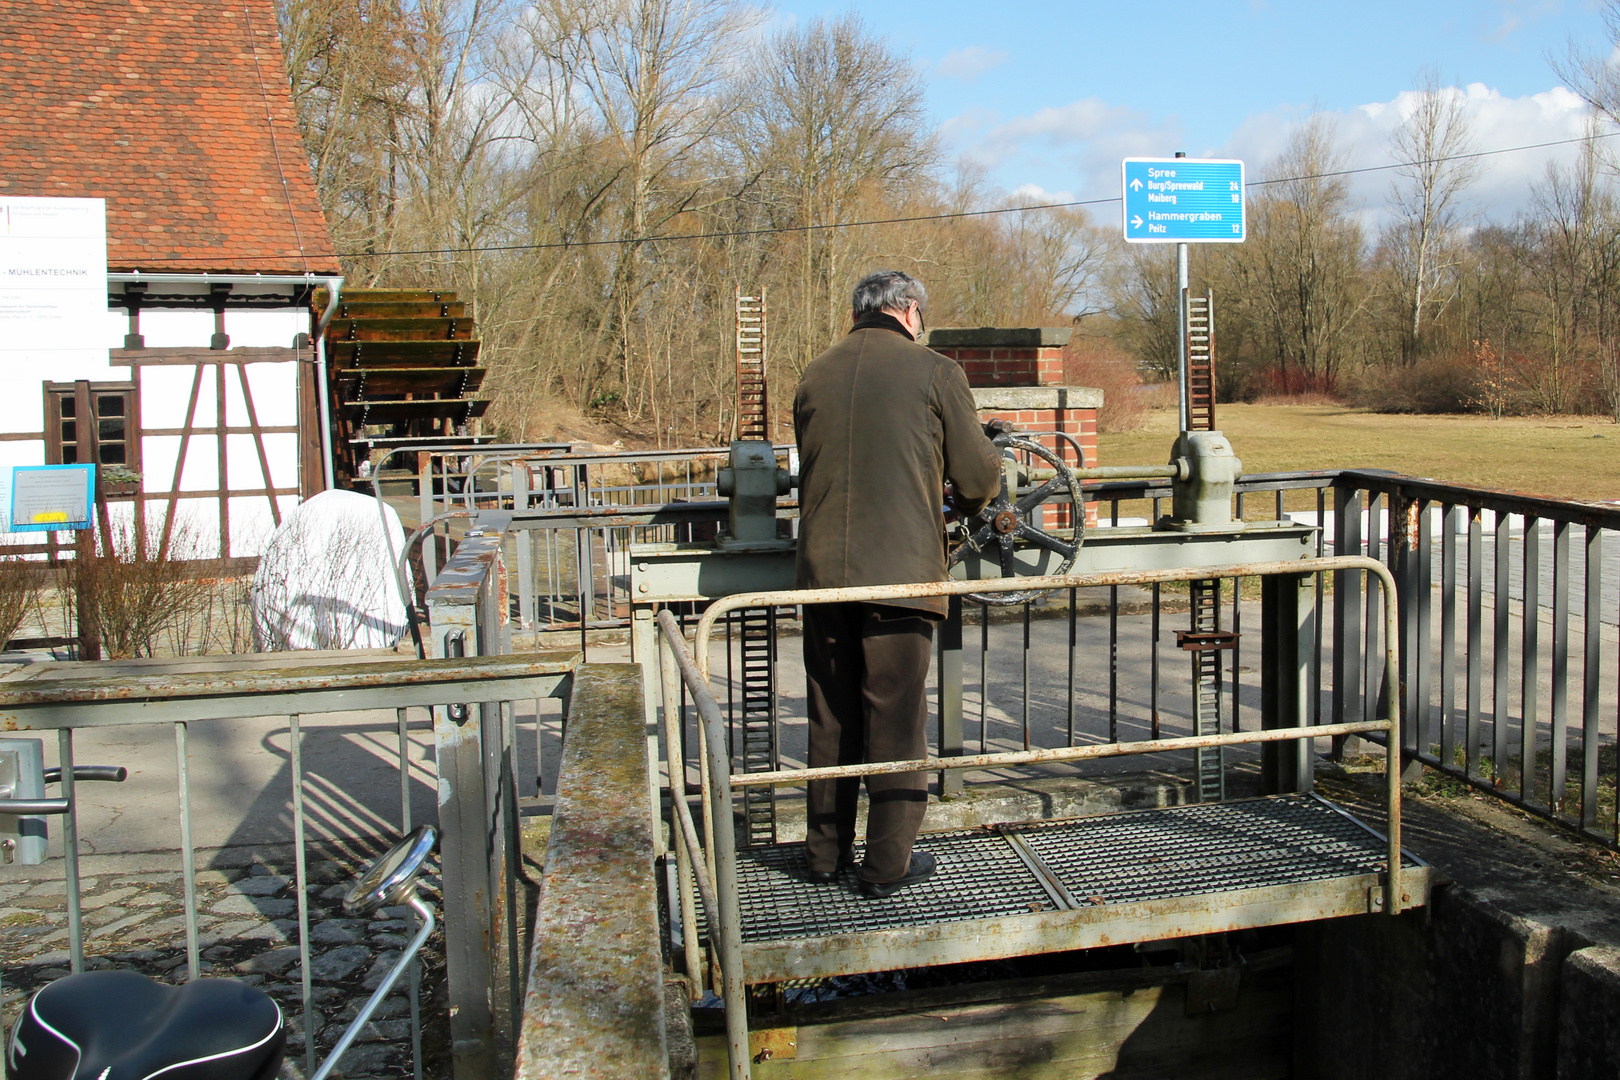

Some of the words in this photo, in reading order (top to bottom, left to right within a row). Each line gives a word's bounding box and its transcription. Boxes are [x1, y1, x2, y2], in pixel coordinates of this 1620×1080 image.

[1148, 167, 1176, 179] Spree
[1148, 181, 1204, 192] Burg/Spreewald
[1229, 181, 1239, 191] 24
[1148, 193, 1177, 205] Maiberg
[1148, 211, 1222, 223] Hammergraben
[1149, 223, 1167, 233] Peitz
[1232, 224, 1240, 233] 12
[8, 267, 88, 276] MÜHLENTECHNIK
